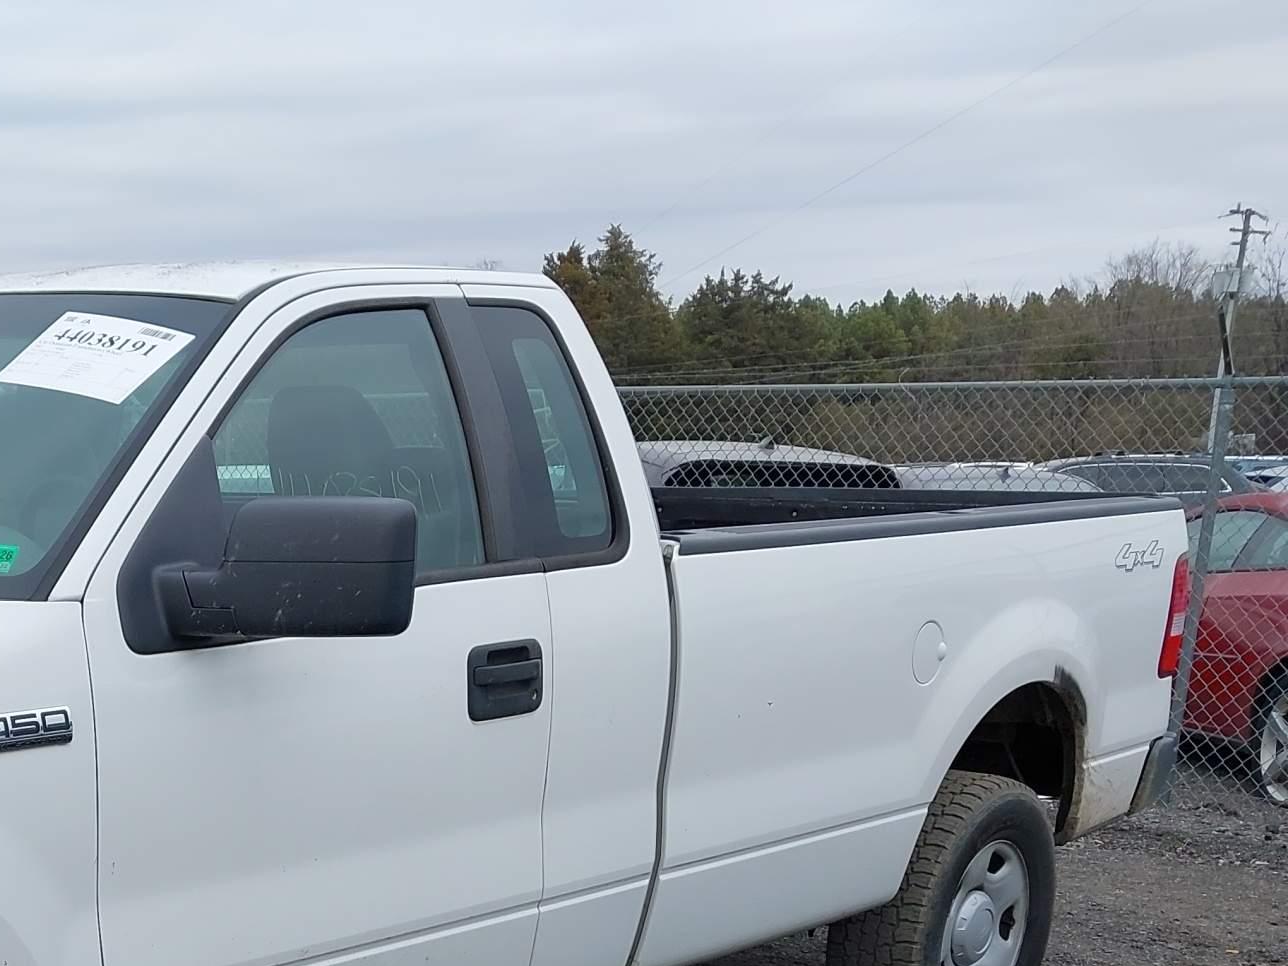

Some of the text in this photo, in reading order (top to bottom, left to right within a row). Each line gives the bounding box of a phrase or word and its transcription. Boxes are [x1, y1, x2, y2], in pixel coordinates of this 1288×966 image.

[54, 328, 158, 356] 44038191
[0, 550, 14, 561] 26
[1114, 540, 1165, 572] 4x4
